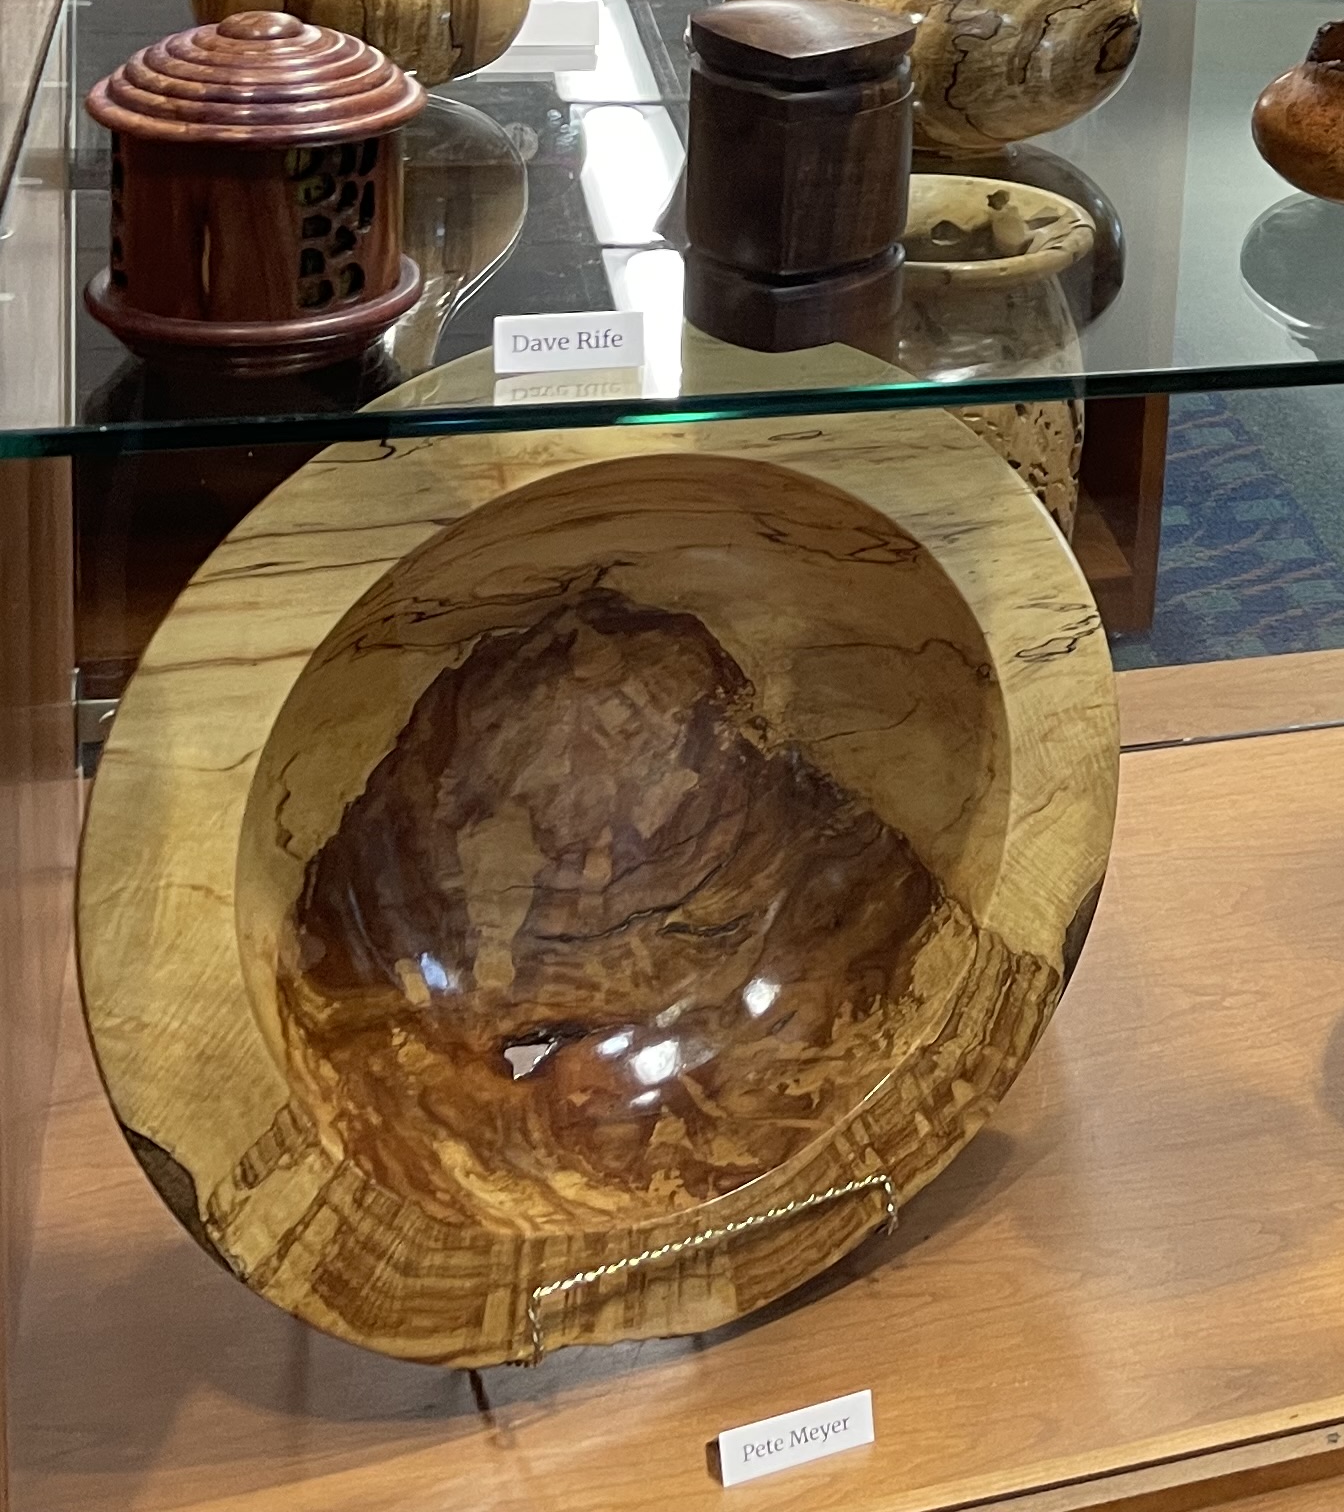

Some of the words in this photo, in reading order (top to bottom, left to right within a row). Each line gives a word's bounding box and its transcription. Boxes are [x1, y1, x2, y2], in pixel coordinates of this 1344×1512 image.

[512, 334, 569, 353] Dave
[576, 328, 623, 350] Rife
[743, 1438, 784, 1463] Pete
[789, 1416, 851, 1448] Meyer
